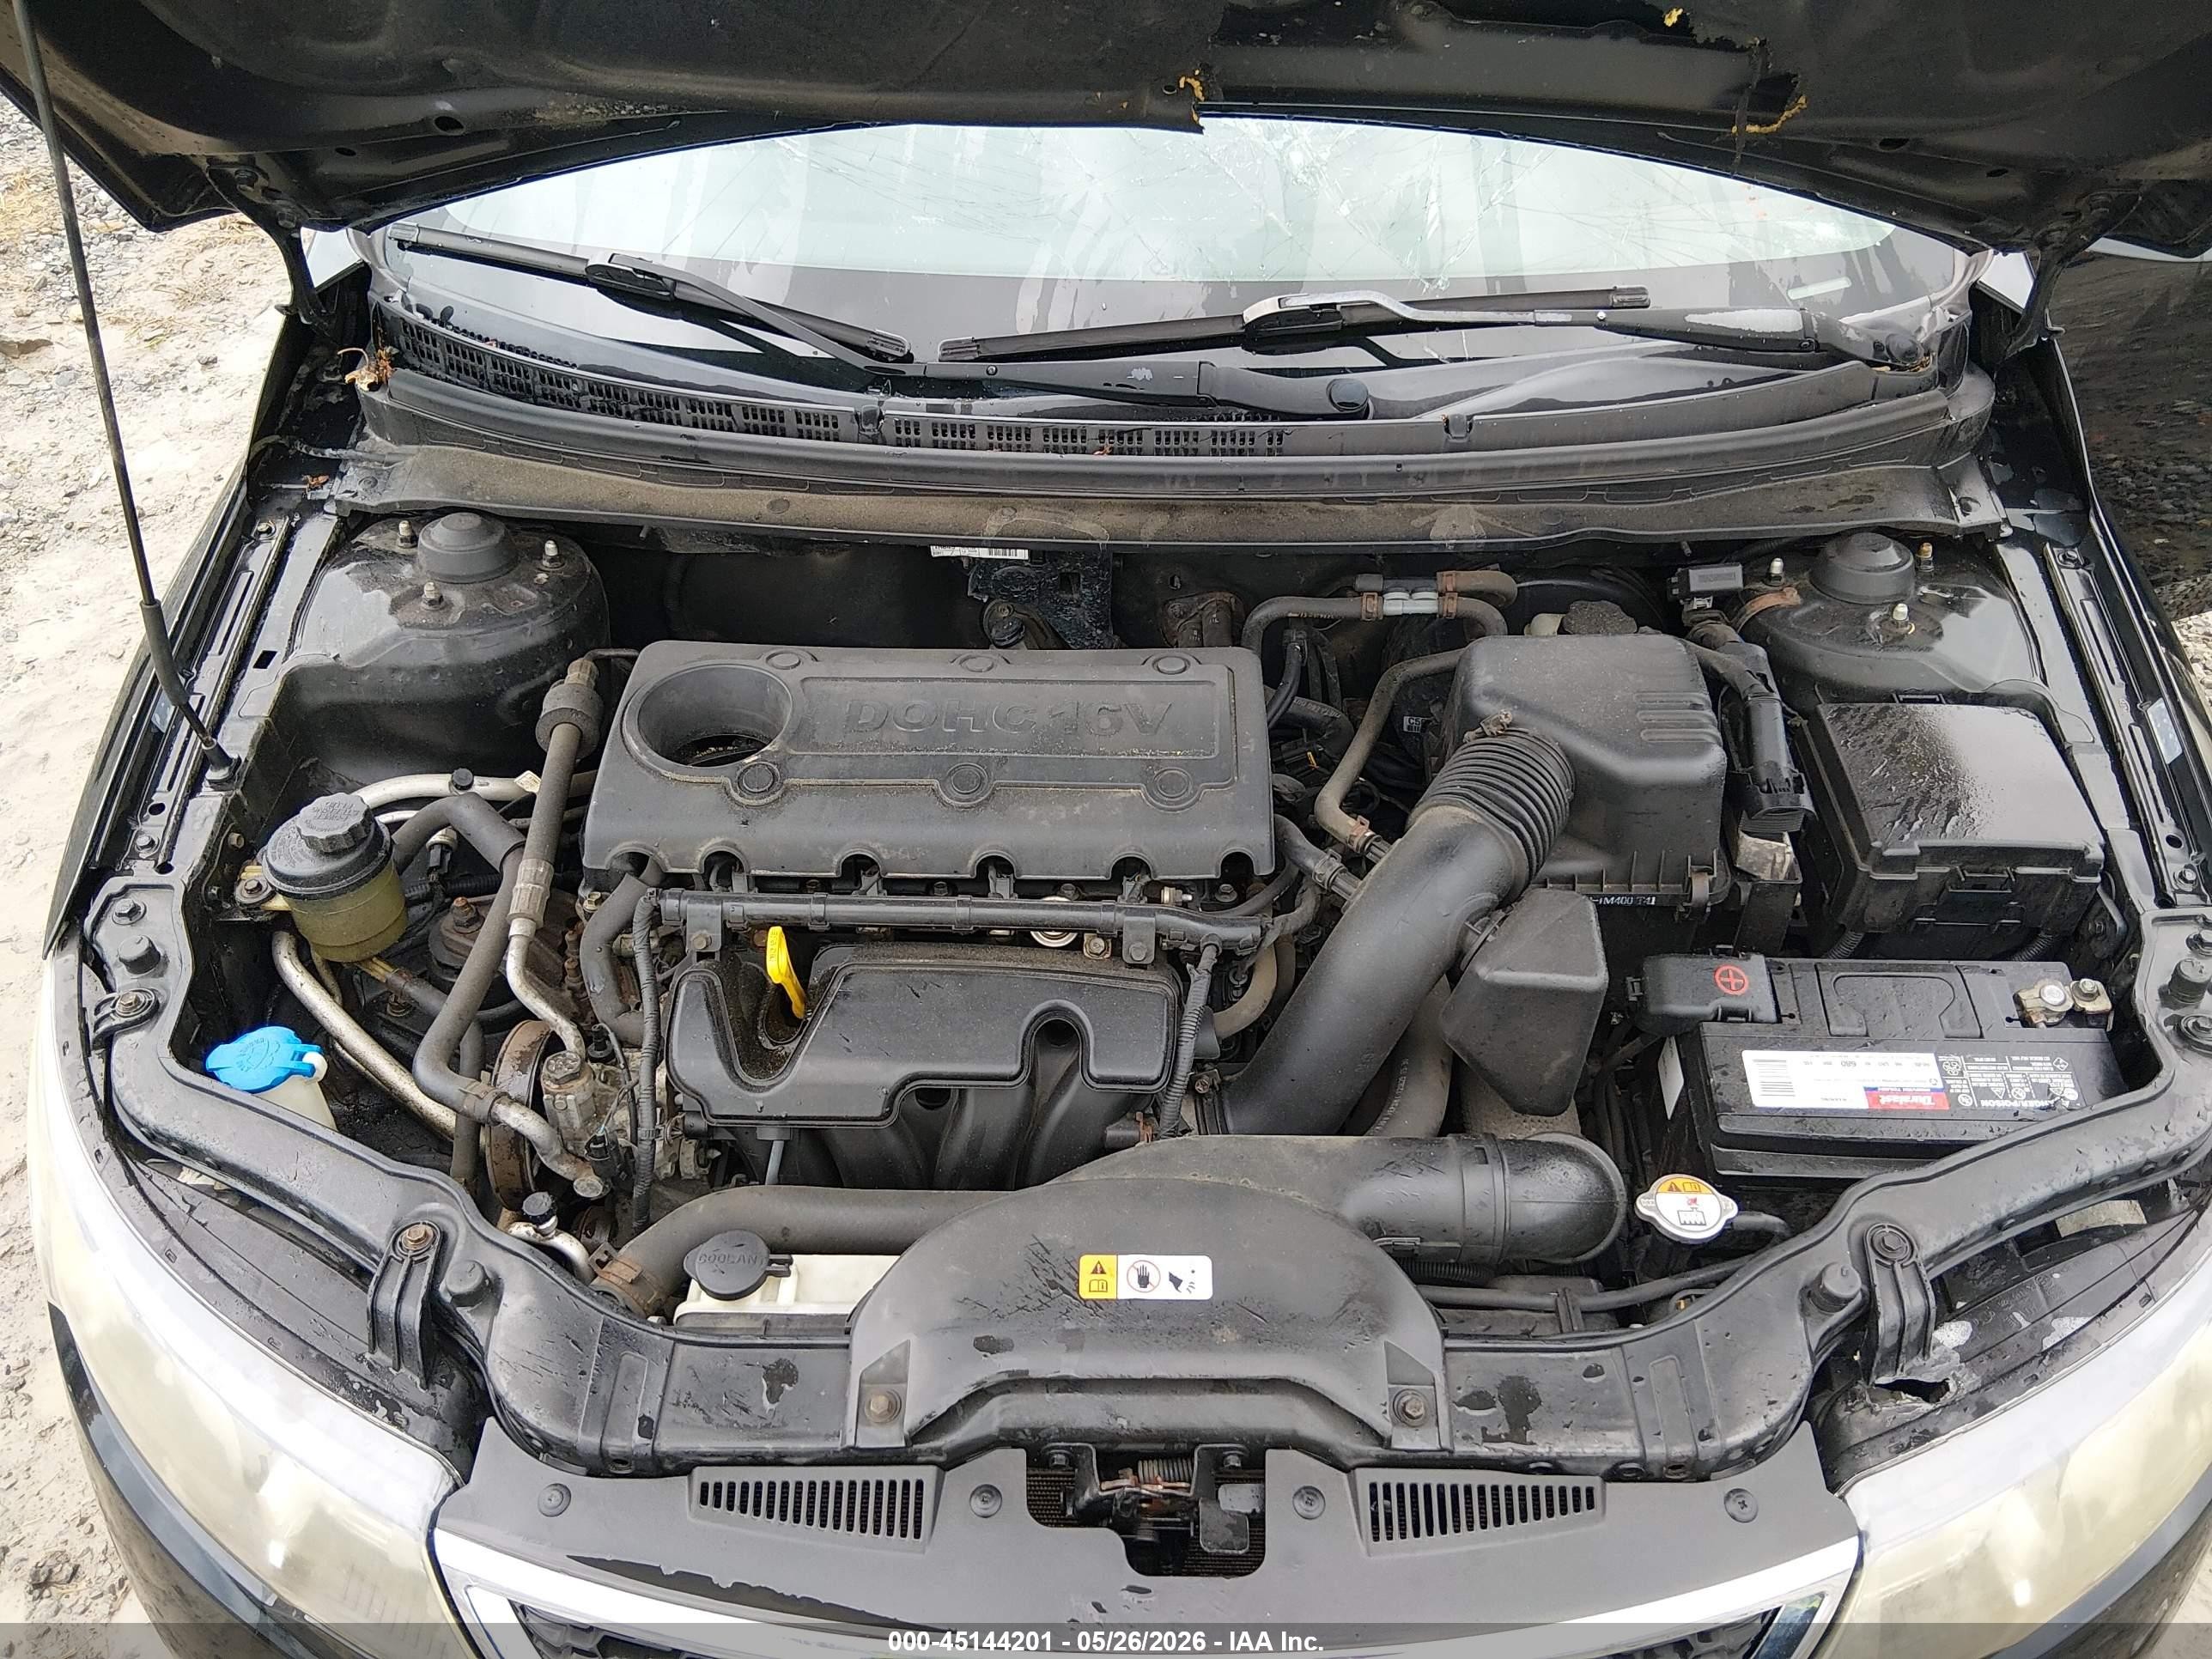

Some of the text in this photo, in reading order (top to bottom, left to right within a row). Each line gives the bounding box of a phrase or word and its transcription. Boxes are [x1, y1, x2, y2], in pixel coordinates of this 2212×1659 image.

[842, 698, 1173, 738] DOHC 16V
[1879, 1094, 1936, 1107] Duralast
[698, 1252, 765, 1266] COOLANT
